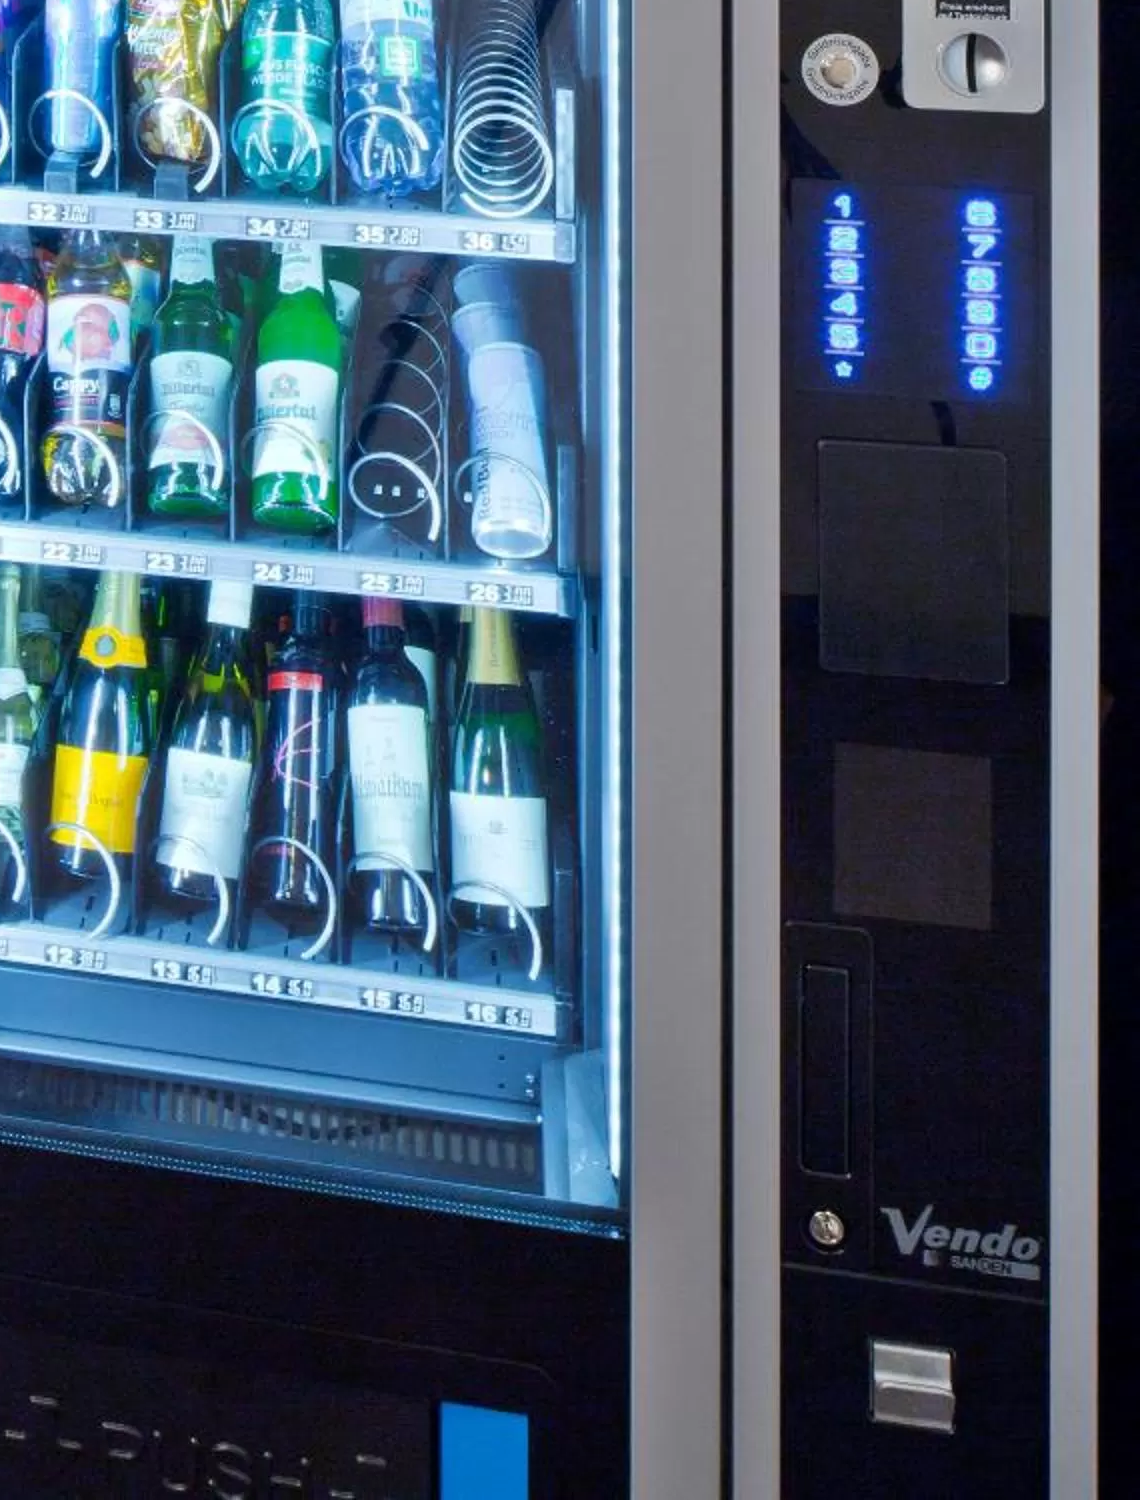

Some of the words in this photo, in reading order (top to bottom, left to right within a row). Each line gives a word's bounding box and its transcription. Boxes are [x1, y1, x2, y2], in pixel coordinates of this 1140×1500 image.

[30, 203, 57, 221] 32
[834, 194, 851, 218] 1
[135, 210, 163, 228] 33
[248, 217, 277, 236] 34
[356, 225, 385, 244] 35
[464, 232, 493, 251] 36
[967, 234, 996, 258] 7
[830, 292, 857, 317] 4
[44, 542, 71, 560] 22
[254, 562, 282, 581] 24
[362, 573, 390, 592] 25
[470, 583, 499, 602] 26
[46, 944, 73, 965] 12
[153, 960, 180, 980] 13
[253, 974, 279, 995] 14
[362, 989, 391, 1009] 15
[468, 1003, 497, 1023] 16
[879, 1203, 1041, 1261] Vendo
